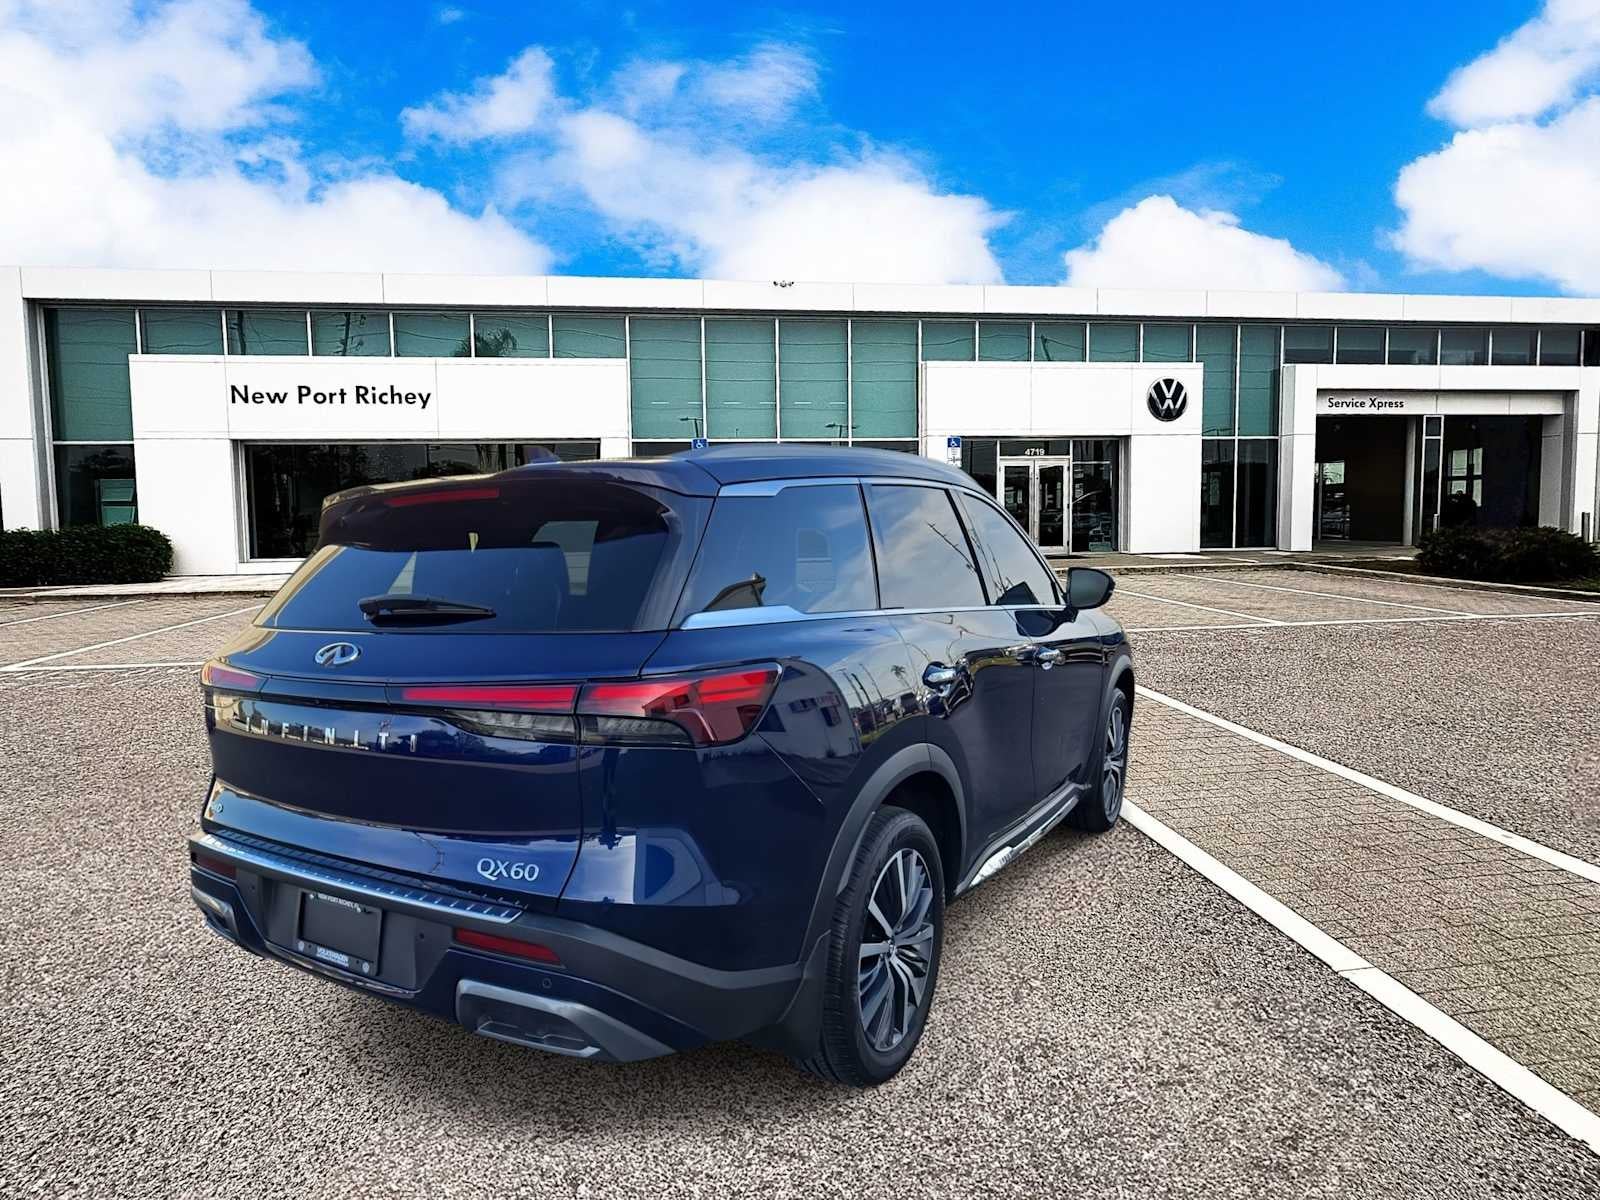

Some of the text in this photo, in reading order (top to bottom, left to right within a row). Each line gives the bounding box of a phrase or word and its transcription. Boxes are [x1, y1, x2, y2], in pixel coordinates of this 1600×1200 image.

[230, 384, 431, 409] New Port Richey
[1328, 397, 1404, 410] Service Xpress
[1024, 448, 1045, 456] 4719
[245, 717, 417, 752] INFINITI
[476, 857, 539, 881] QX60
